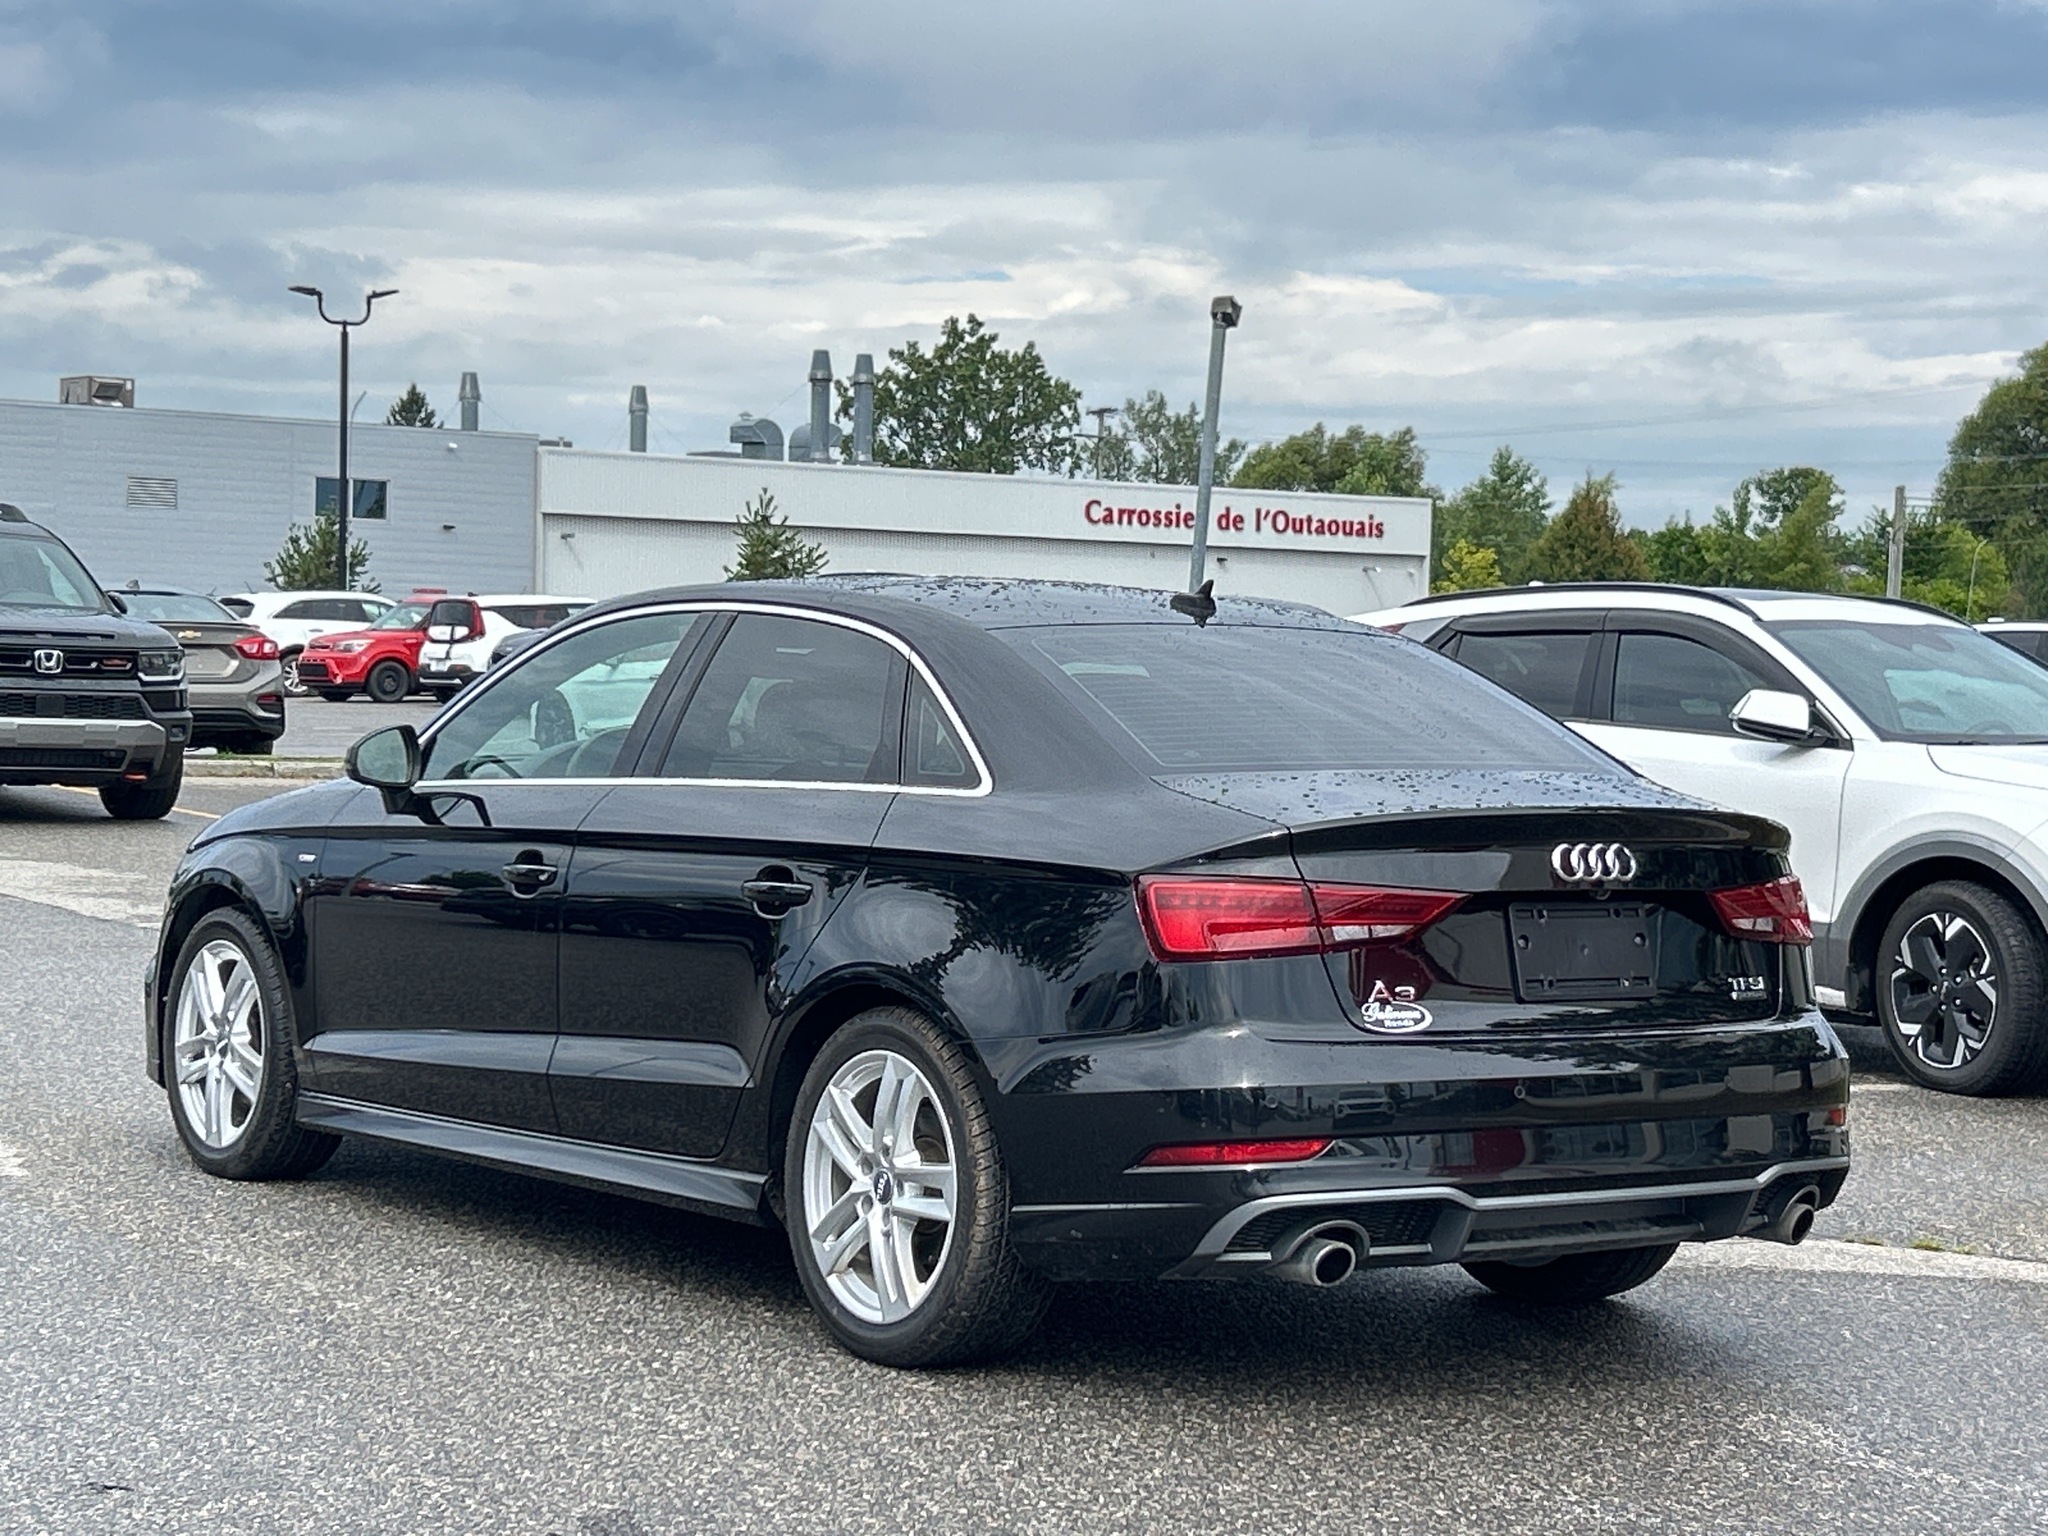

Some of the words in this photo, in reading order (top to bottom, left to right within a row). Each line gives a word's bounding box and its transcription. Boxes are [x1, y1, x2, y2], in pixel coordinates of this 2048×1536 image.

[1084, 499, 1196, 529] Carrossie
[1217, 506, 1244, 531] de
[1255, 508, 1384, 538] l'Outaouais
[1368, 980, 1415, 1003] A3
